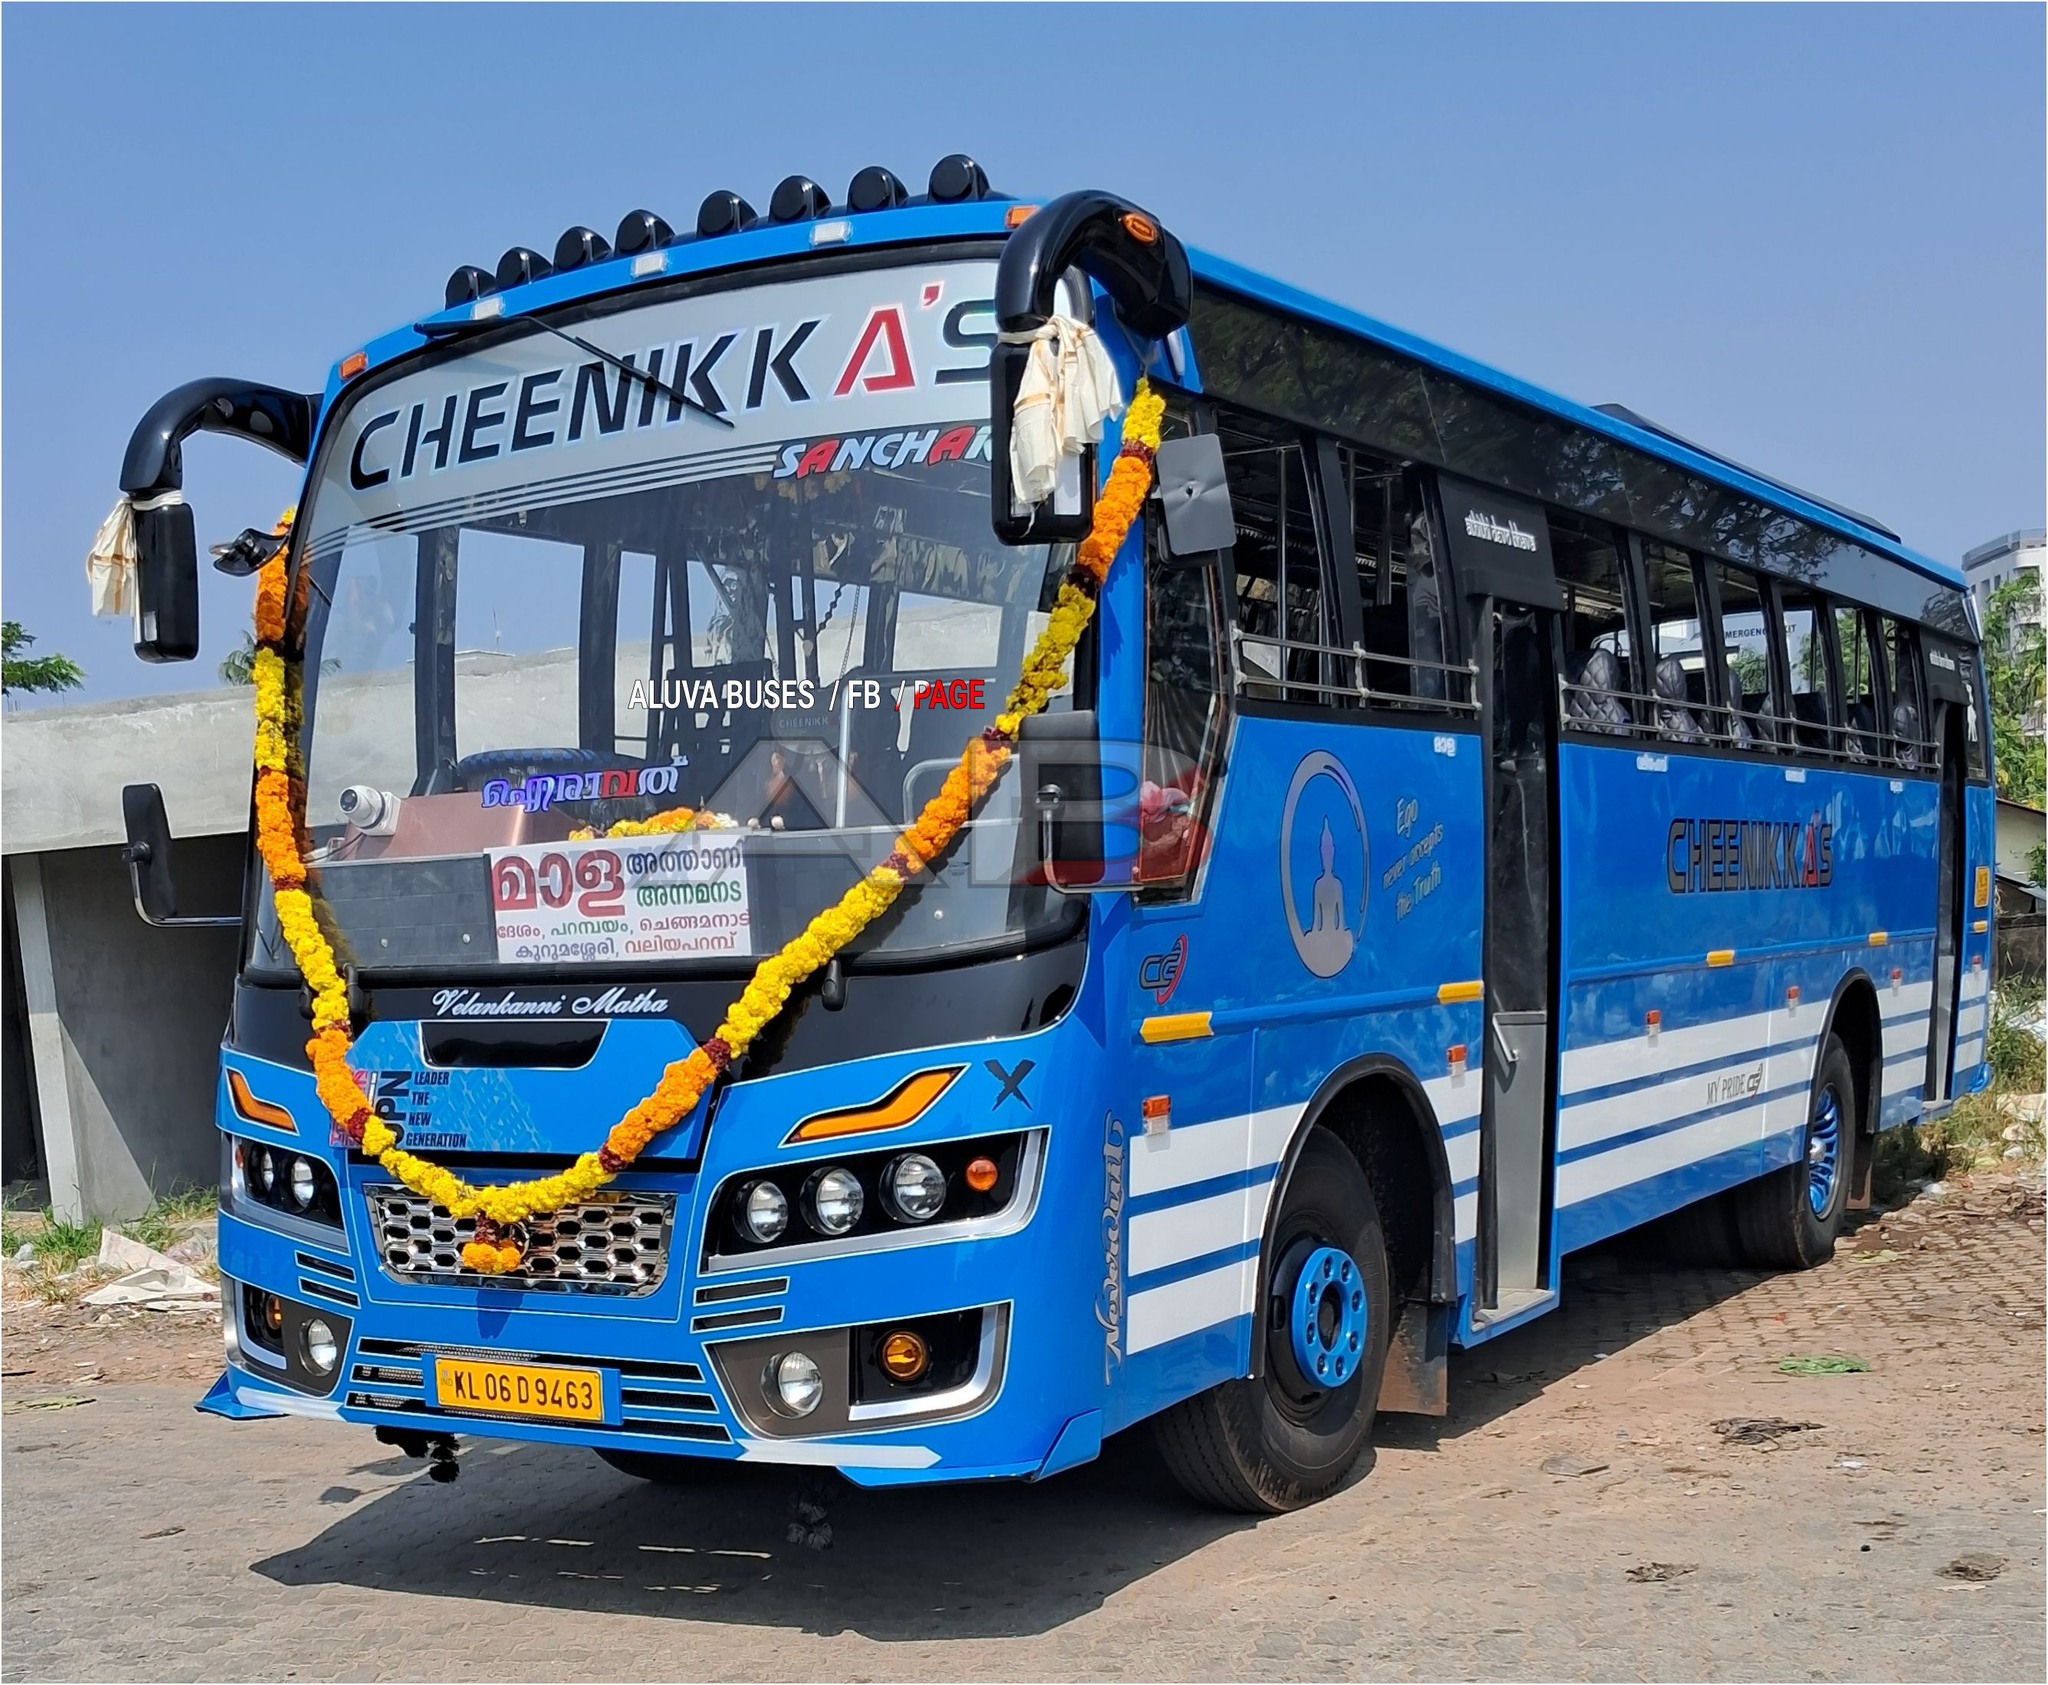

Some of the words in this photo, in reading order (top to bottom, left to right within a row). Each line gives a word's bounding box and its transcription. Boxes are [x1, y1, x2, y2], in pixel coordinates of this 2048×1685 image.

[350, 284, 998, 492] CHEENIKKA'S
[1396, 798, 1418, 838] Ego
[492, 850, 626, 918] മാള
[636, 880, 742, 907] അന്നമനട
[432, 988, 567, 1016] Velankanni
[571, 987, 669, 1015] Matha
[413, 1071, 450, 1086] LEADER
[1722, 1074, 1746, 1100] PRIDE
[411, 1092, 430, 1106] THE
[408, 1112, 432, 1126] NEW
[406, 1132, 467, 1148] GENERATION
